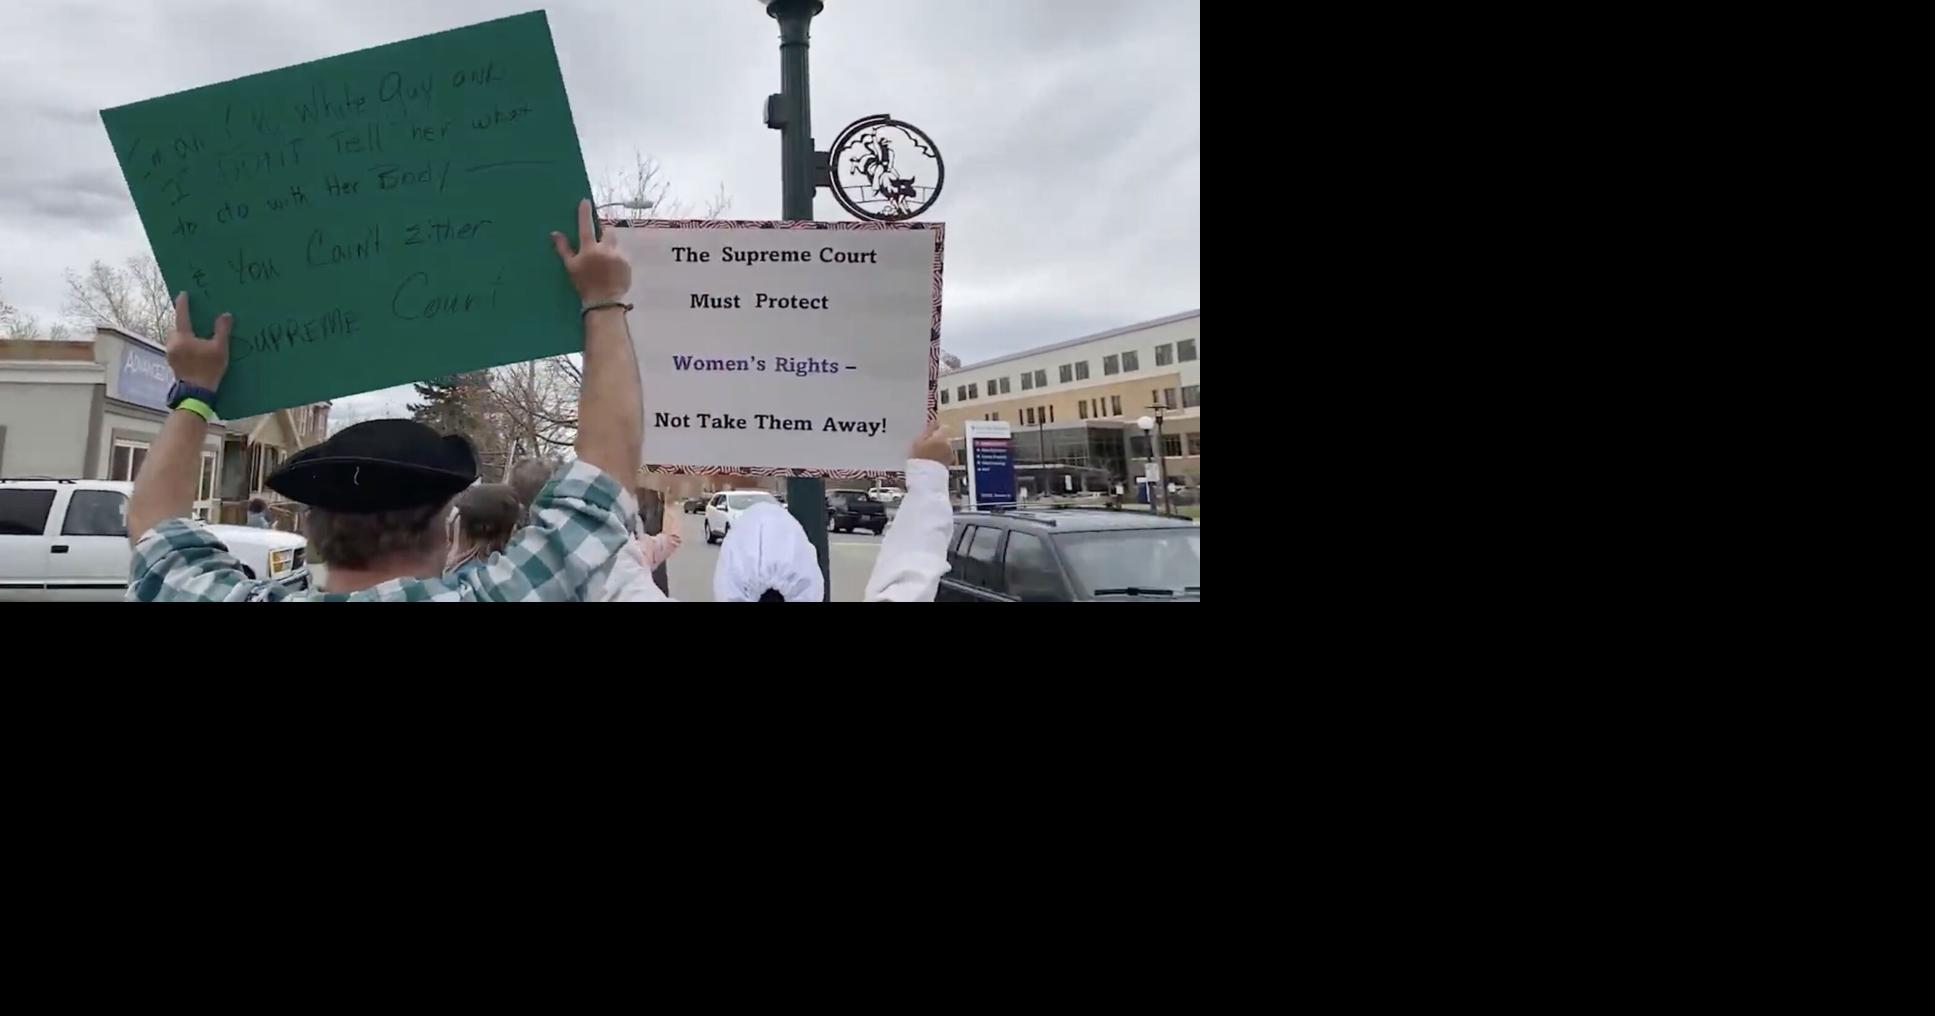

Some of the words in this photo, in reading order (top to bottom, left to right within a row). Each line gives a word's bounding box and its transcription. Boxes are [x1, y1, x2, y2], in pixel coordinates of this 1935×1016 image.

[330, 120, 383, 153] Tell
[412, 121, 450, 142] her
[216, 201, 250, 224] do
[324, 172, 360, 197] Her
[228, 247, 280, 284] You
[671, 247, 711, 263] The
[721, 247, 812, 266] Supreme
[819, 248, 877, 264] Court
[690, 294, 741, 309] Must
[755, 294, 829, 310] Protect
[672, 355, 766, 372] Women's
[775, 357, 839, 377] Rights
[654, 413, 690, 428] Not
[697, 413, 747, 430] Take
[754, 415, 813, 431] Them
[822, 417, 887, 437] Away!
